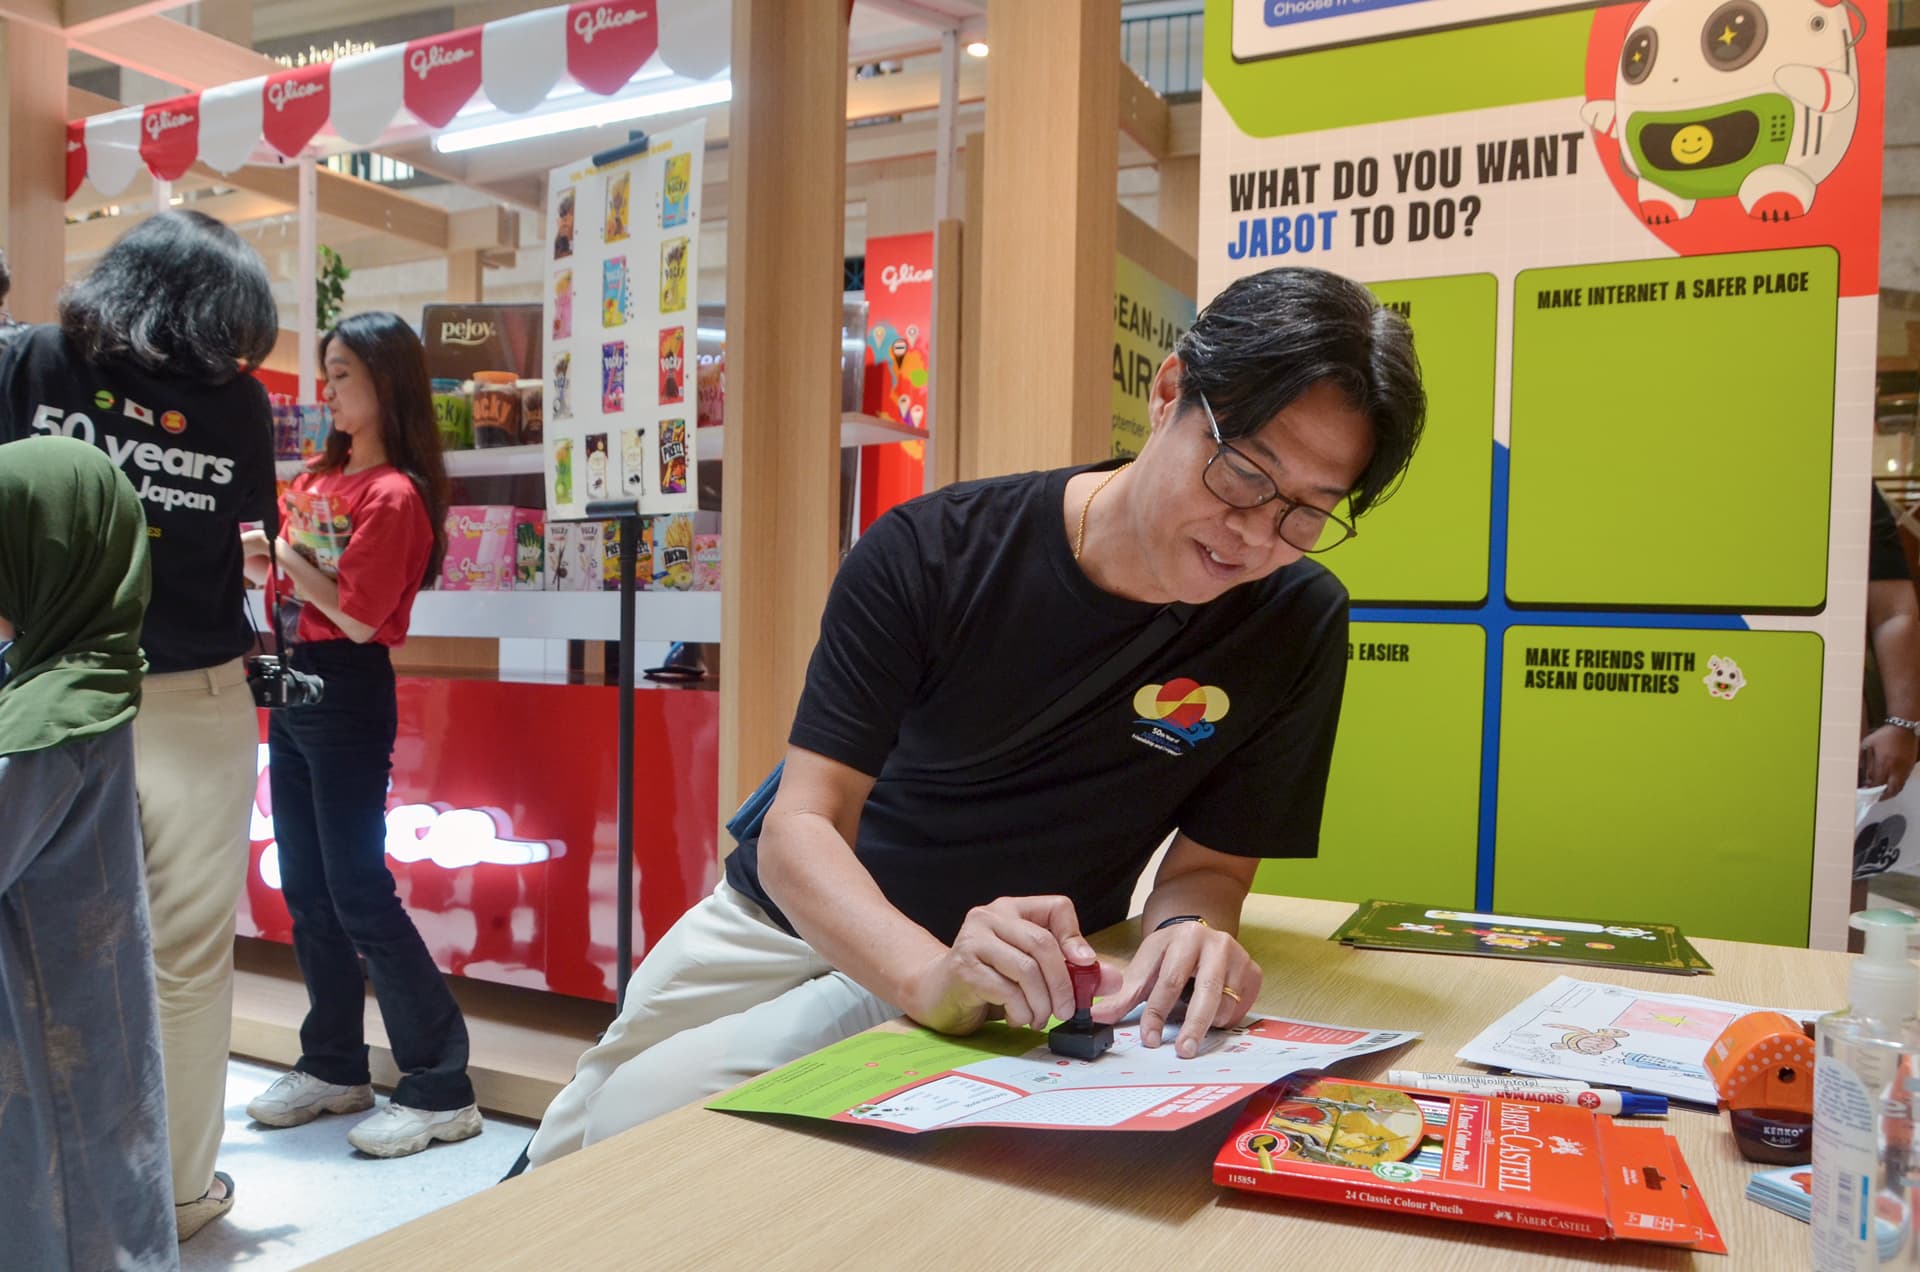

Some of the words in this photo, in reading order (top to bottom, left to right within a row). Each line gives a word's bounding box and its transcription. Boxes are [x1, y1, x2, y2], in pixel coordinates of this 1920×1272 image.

[574, 8, 648, 44] Glico
[410, 45, 474, 79] Glico
[268, 80, 324, 112] Glico
[145, 112, 194, 140] Glico
[1230, 164, 1321, 212] WHAT
[1333, 157, 1379, 201] DO
[1393, 146, 1462, 193] YOU
[1476, 131, 1585, 185] WANT
[1227, 210, 1338, 260] JABOT
[1350, 204, 1394, 247] TO
[1408, 195, 1482, 242] DO?
[881, 263, 934, 294] Glico
[1537, 288, 1582, 309] MAKE
[1587, 281, 1669, 306] INTERNET
[1675, 280, 1686, 300] A
[1692, 276, 1747, 299] SAFER
[1752, 272, 1809, 295] PLACE
[1113, 342, 1161, 402] AIR
[30, 404, 96, 446] 50
[105, 435, 235, 484] years
[137, 475, 216, 511] Japan
[1360, 643, 1410, 662] EASIER
[1525, 648, 1570, 668] MAKE
[1575, 649, 1645, 670] FRIENDS
[1650, 651, 1696, 672] WITH
[1524, 669, 1577, 690] ASEAN
[1583, 671, 1679, 694] COUNTRIES
[1498, 1102, 1543, 1191] FABER-CASTELL
[1228, 1174, 1257, 1185] 115854
[1345, 1190, 1357, 1200] 24
[1359, 1191, 1392, 1205] Classic
[1394, 1196, 1427, 1210] Colour
[1429, 1201, 1464, 1215] Pencils
